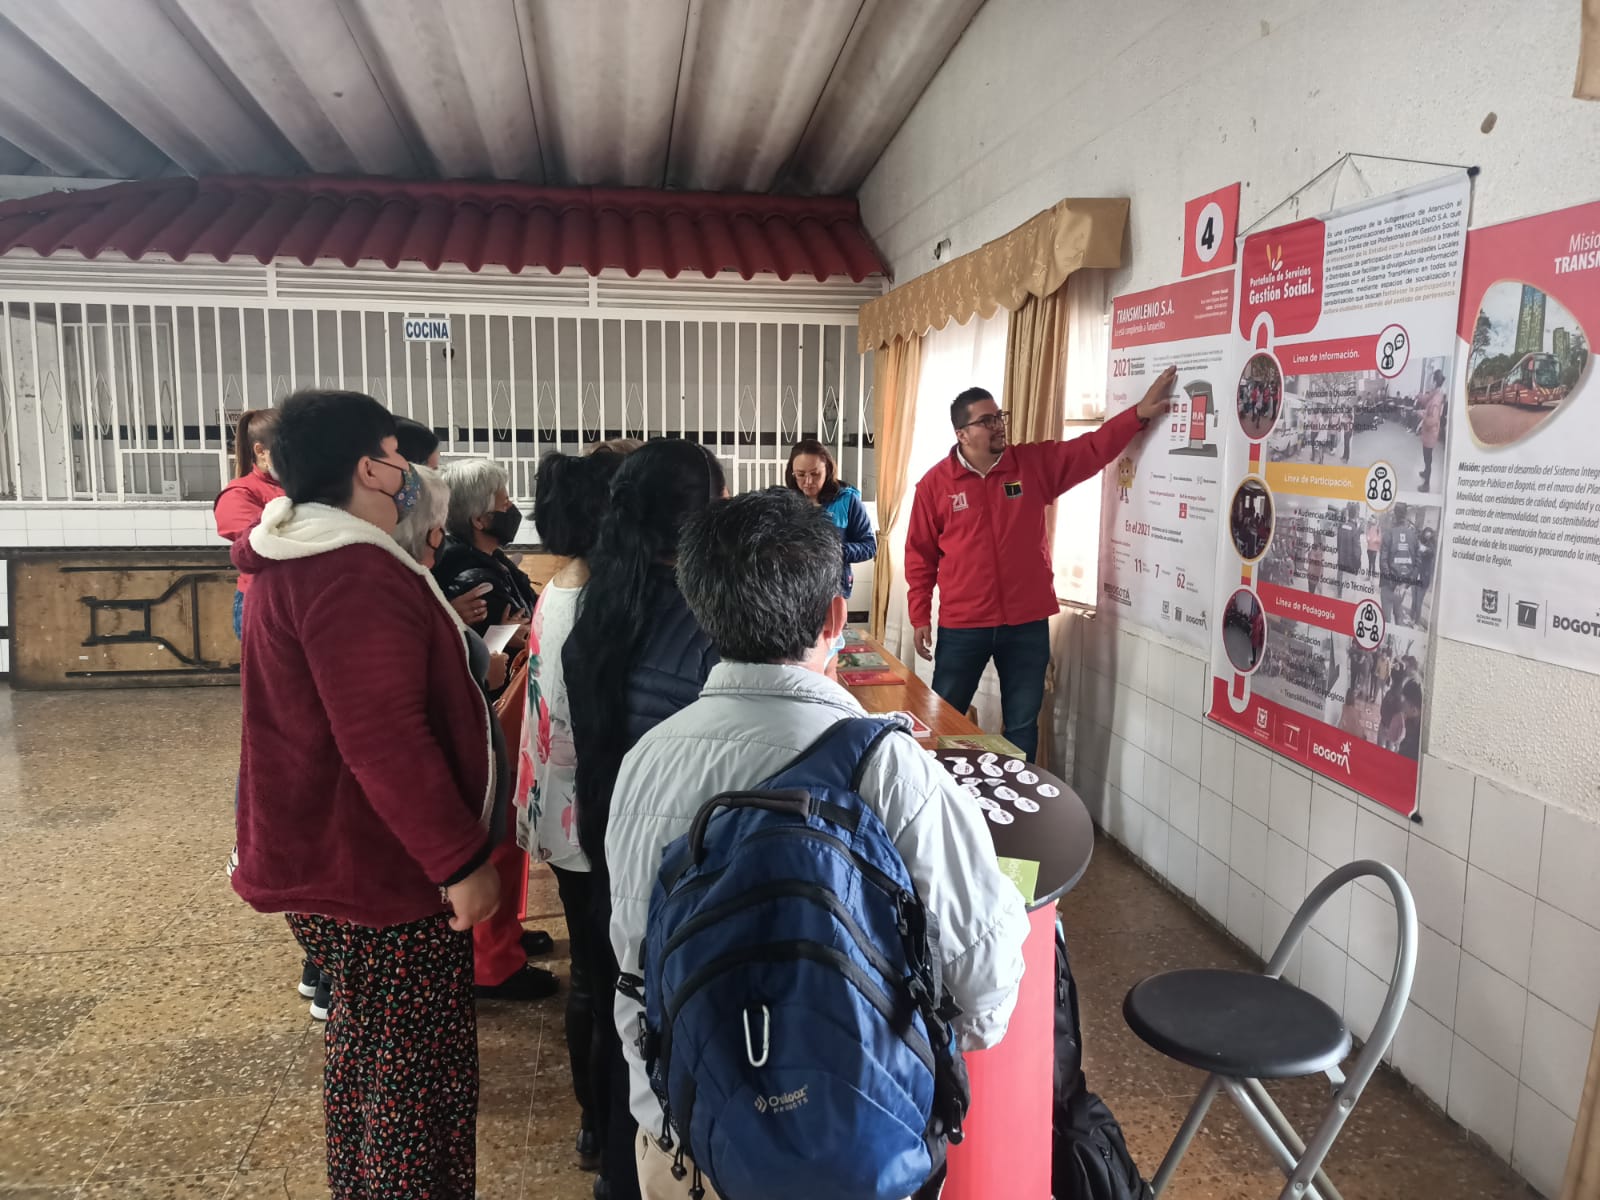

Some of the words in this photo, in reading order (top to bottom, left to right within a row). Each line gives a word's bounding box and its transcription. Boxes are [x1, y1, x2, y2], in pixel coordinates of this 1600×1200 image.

[1428, 201, 1453, 213] Atención
[1394, 214, 1436, 230] TRANSMILENIO
[1201, 216, 1214, 250] 4
[1378, 231, 1411, 244] Profesionales
[1420, 225, 1441, 235] Gestión
[1404, 245, 1437, 256] Autoridades
[1437, 240, 1459, 250] Locales
[1417, 256, 1425, 264] de
[1430, 262, 1447, 271] todos
[1276, 270, 1284, 281] de
[1285, 266, 1311, 280] Servicios
[1249, 285, 1281, 305] Gestión
[1283, 277, 1315, 299] Social.
[1117, 301, 1160, 324] TRANSMILENIO
[1161, 298, 1175, 316] S.A.
[405, 321, 449, 339] COCINA
[1309, 353, 1318, 362] de
[1319, 349, 1360, 361] Información.
[1113, 358, 1131, 377] 2021
[1458, 462, 1480, 472] Misión:
[1481, 464, 1507, 475] gestionar
[1508, 464, 1514, 474] el
[1514, 464, 1542, 475] desarrollo
[1542, 465, 1553, 475] del
[1554, 465, 1580, 477] Sistema
[1300, 475, 1308, 484] de
[1458, 477, 1487, 489] Transporte
[1487, 478, 1506, 489] Público
[1506, 481, 1514, 489] en
[1537, 483, 1546, 492] en
[1547, 482, 1554, 492] el
[1555, 484, 1574, 493] marco
[1575, 482, 1586, 494] del
[1484, 495, 1495, 503] con
[1495, 494, 1525, 505] estándares
[1526, 496, 1534, 506] de
[1559, 499, 1589, 512] dignidad
[1589, 504, 1594, 513] y
[1456, 508, 1465, 516] con
[1465, 508, 1487, 517] criterios
[1487, 508, 1495, 518] de
[1540, 516, 1551, 524] con
[1552, 515, 1600, 529] sostenibilidad
[1125, 520, 1131, 532] En
[1132, 521, 1137, 534] el
[1137, 522, 1151, 537] 2021
[1481, 525, 1492, 534] con
[1492, 526, 1504, 535] una
[1504, 526, 1537, 539] orientación
[1538, 529, 1556, 540] hacia
[1556, 531, 1564, 541] el
[1452, 535, 1471, 545] calidad
[1471, 536, 1479, 546] de
[1479, 537, 1491, 548] vida
[1491, 539, 1499, 549] de
[1499, 540, 1508, 550] los
[1508, 543, 1533, 554] usuarios
[1533, 546, 1539, 556] y
[1538, 547, 1577, 560] procurando
[1577, 550, 1585, 560] la
[1134, 558, 1142, 573] 11
[1452, 550, 1458, 558] la
[1458, 551, 1475, 561] ciudad
[1475, 554, 1485, 562] con
[1486, 554, 1492, 563] la
[1492, 554, 1513, 567] Región.
[1155, 564, 1160, 579] 7
[1176, 573, 1186, 589] 62
[1351, 581, 1375, 595] Técnicos
[1293, 602, 1301, 610] de
[1302, 603, 1335, 620] Pedagogía
[1552, 615, 1600, 638] BOGOT
